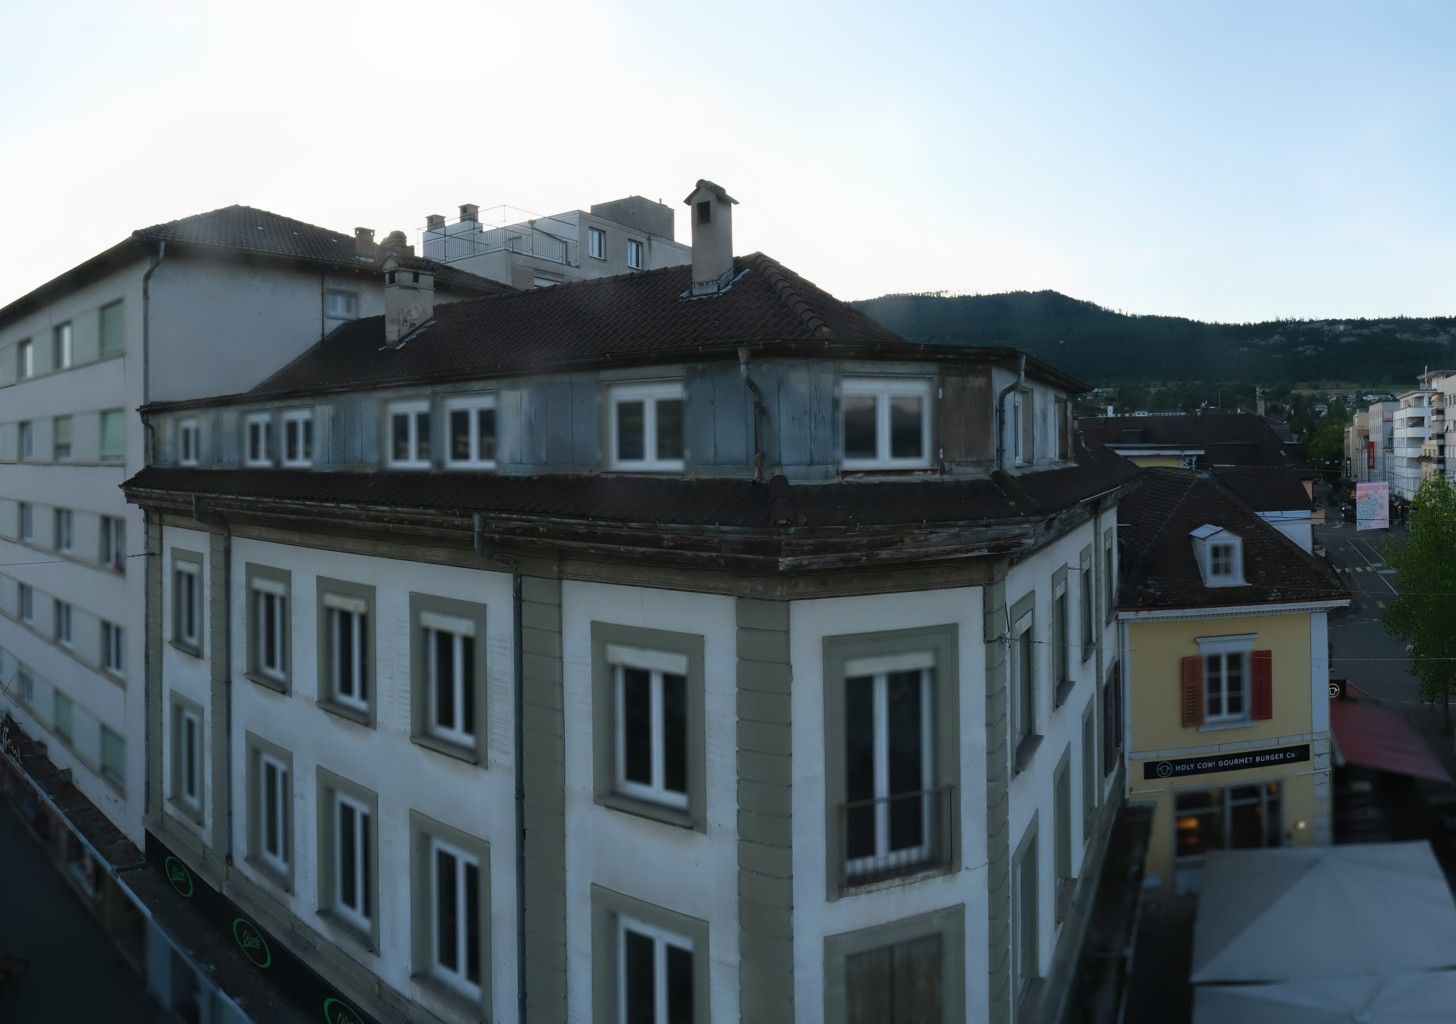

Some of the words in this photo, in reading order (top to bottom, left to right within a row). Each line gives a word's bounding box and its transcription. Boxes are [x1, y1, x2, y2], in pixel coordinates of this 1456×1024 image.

[1174, 763, 1195, 772] HOLY
[1197, 761, 1216, 769] COW!
[1218, 757, 1252, 767] GOURMET
[1255, 752, 1284, 763] BURGER
